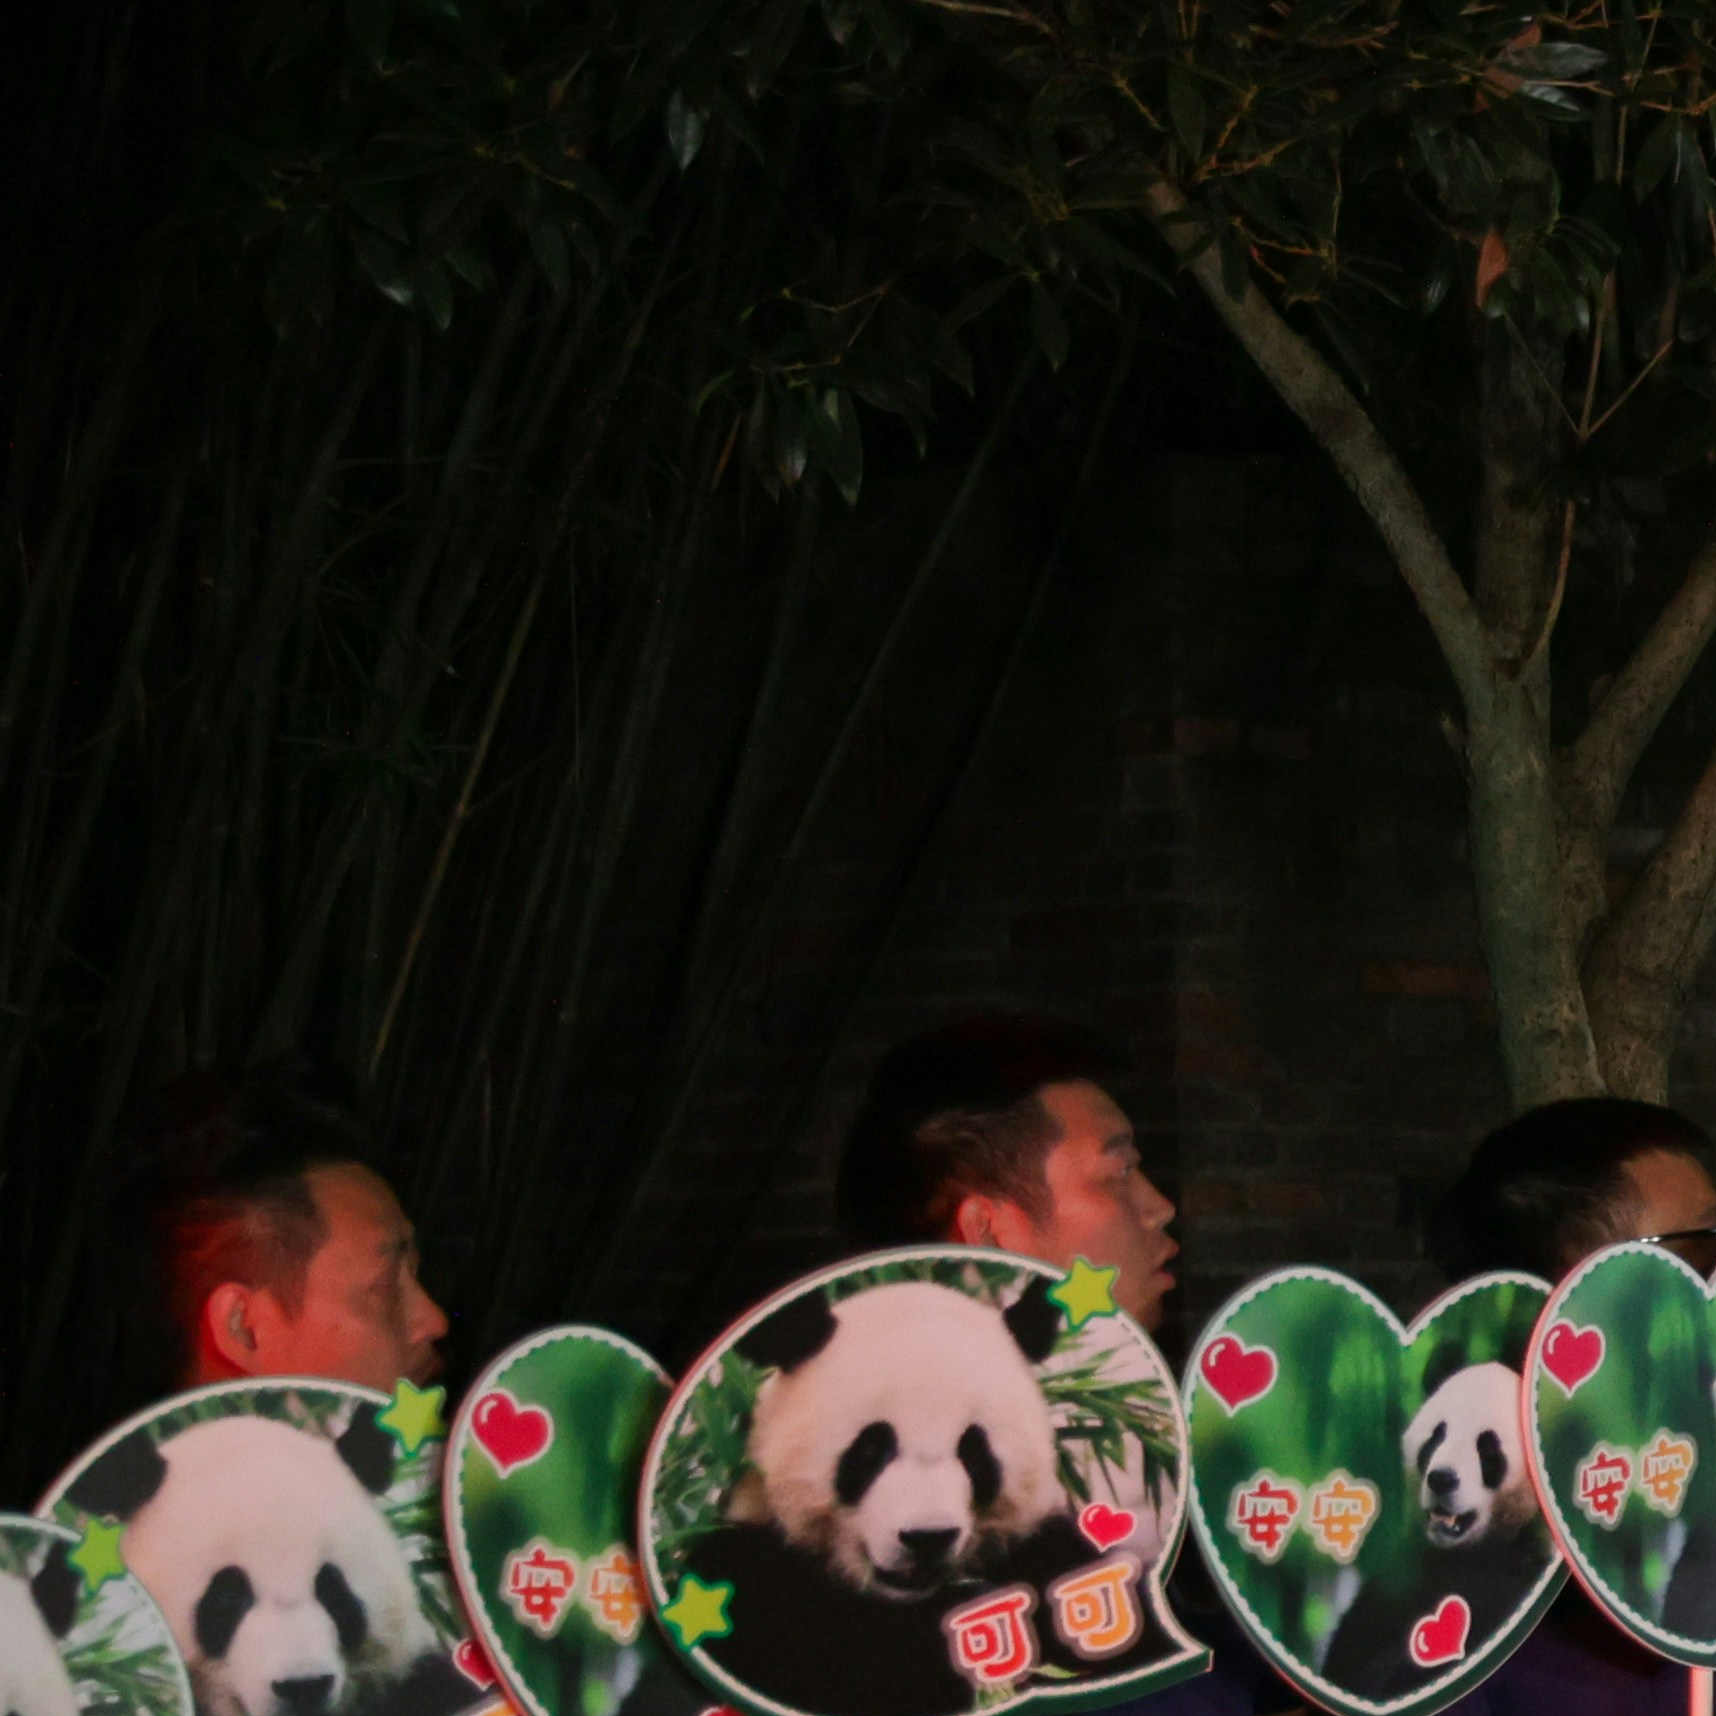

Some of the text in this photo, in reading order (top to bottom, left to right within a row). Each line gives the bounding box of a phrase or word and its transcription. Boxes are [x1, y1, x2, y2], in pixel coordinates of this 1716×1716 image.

[1236, 1478, 1376, 1553] 安安
[1578, 1431, 1694, 1524] 安安
[508, 1541, 645, 1638] 安安
[951, 1562, 1135, 1681] 可可
